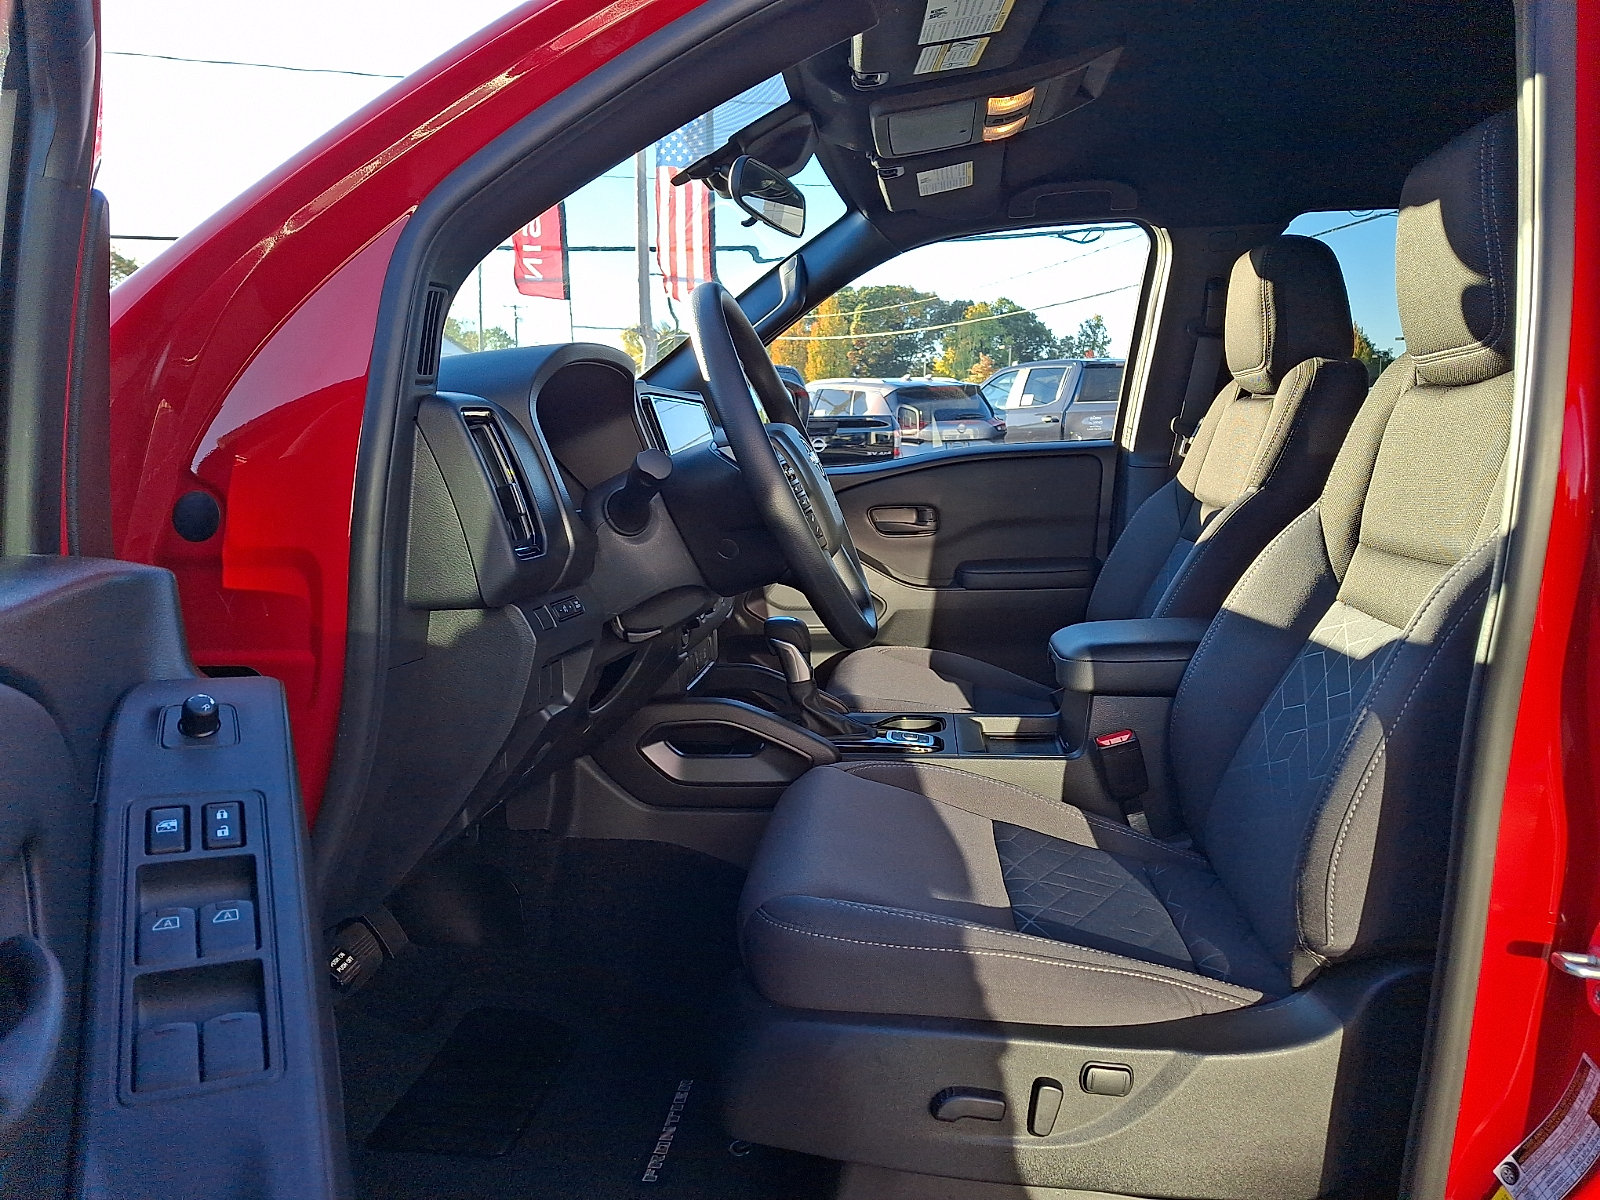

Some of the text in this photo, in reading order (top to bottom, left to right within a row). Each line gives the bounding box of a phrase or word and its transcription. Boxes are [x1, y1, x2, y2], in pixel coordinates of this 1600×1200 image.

[201, 703, 211, 712] R
[336, 962, 348, 973] PUSH
[641, 1079, 694, 1183] FRONTIER
